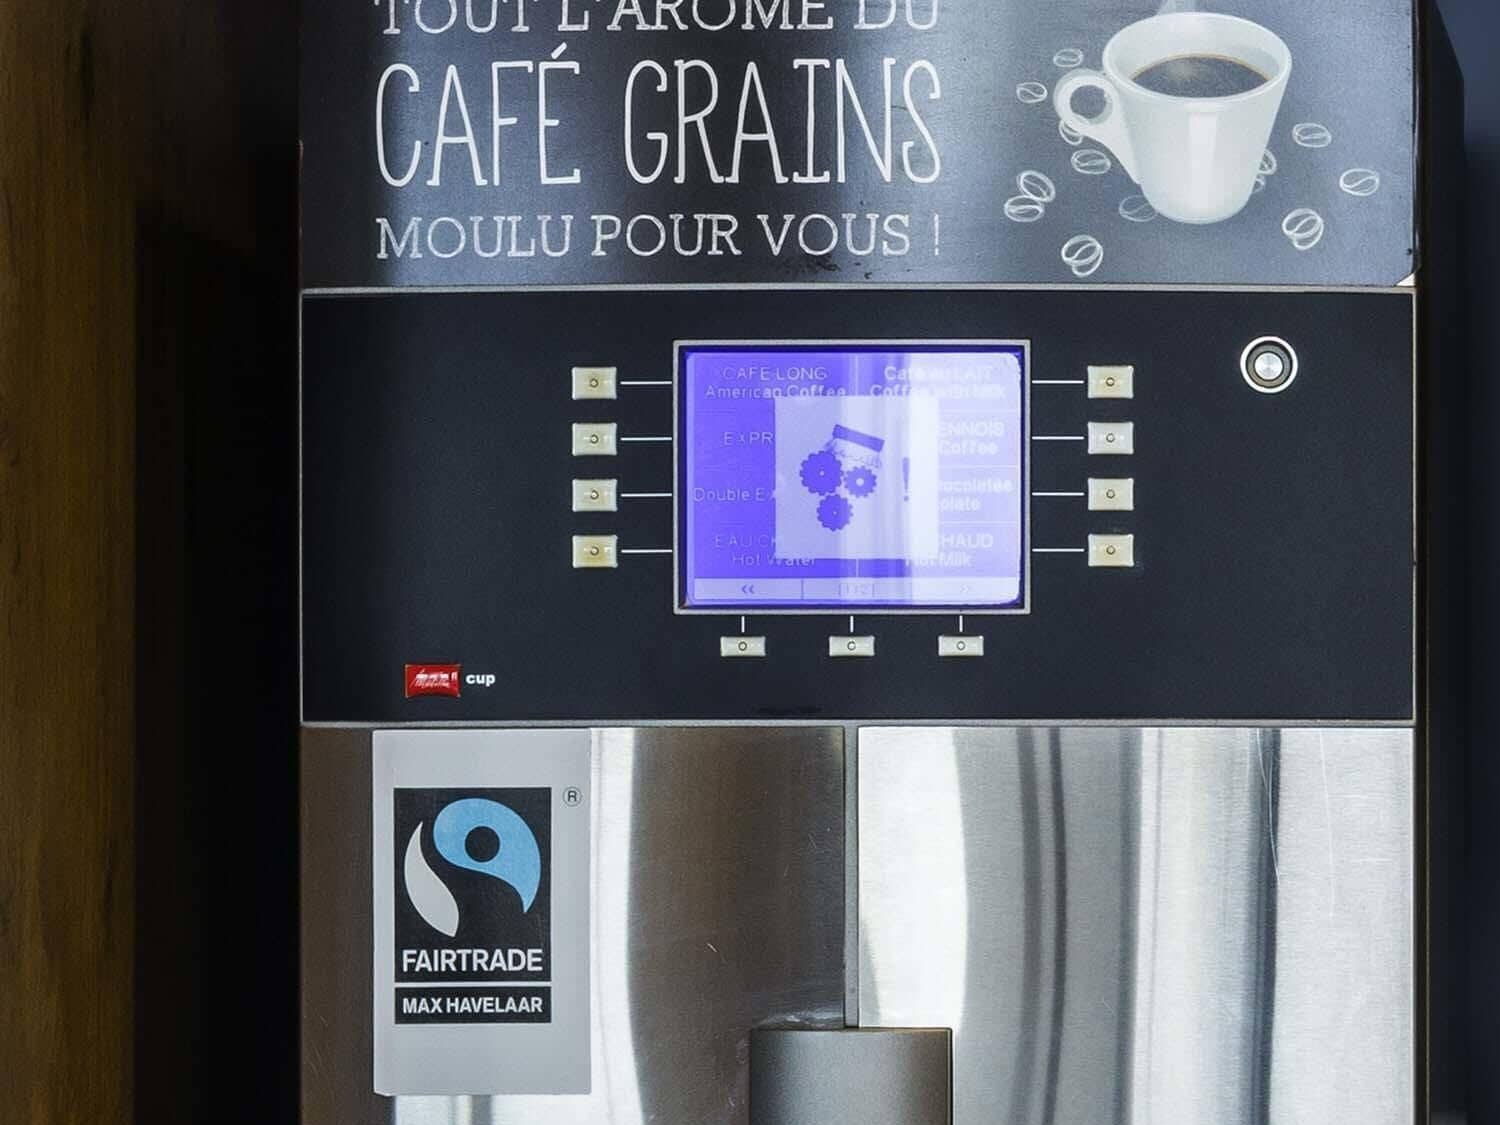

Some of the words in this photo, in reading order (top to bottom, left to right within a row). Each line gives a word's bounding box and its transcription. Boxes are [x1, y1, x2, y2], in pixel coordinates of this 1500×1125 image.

[853, 0, 939, 30] DU
[375, 41, 582, 187] CAFÉ
[623, 57, 942, 185] GRAINS
[376, 214, 573, 260] MOULU
[591, 213, 742, 257] POUR
[757, 212, 911, 257] VOUS
[776, 366, 828, 381] LONG
[705, 384, 784, 399] American
[786, 384, 847, 398] Coffee
[694, 487, 750, 502] Double
[940, 534, 994, 549] HAUD
[465, 674, 496, 687] cup
[402, 948, 543, 972] FAIRTRADE
[402, 998, 441, 1014] MAX
[446, 997, 543, 1014] HAVELAAR
